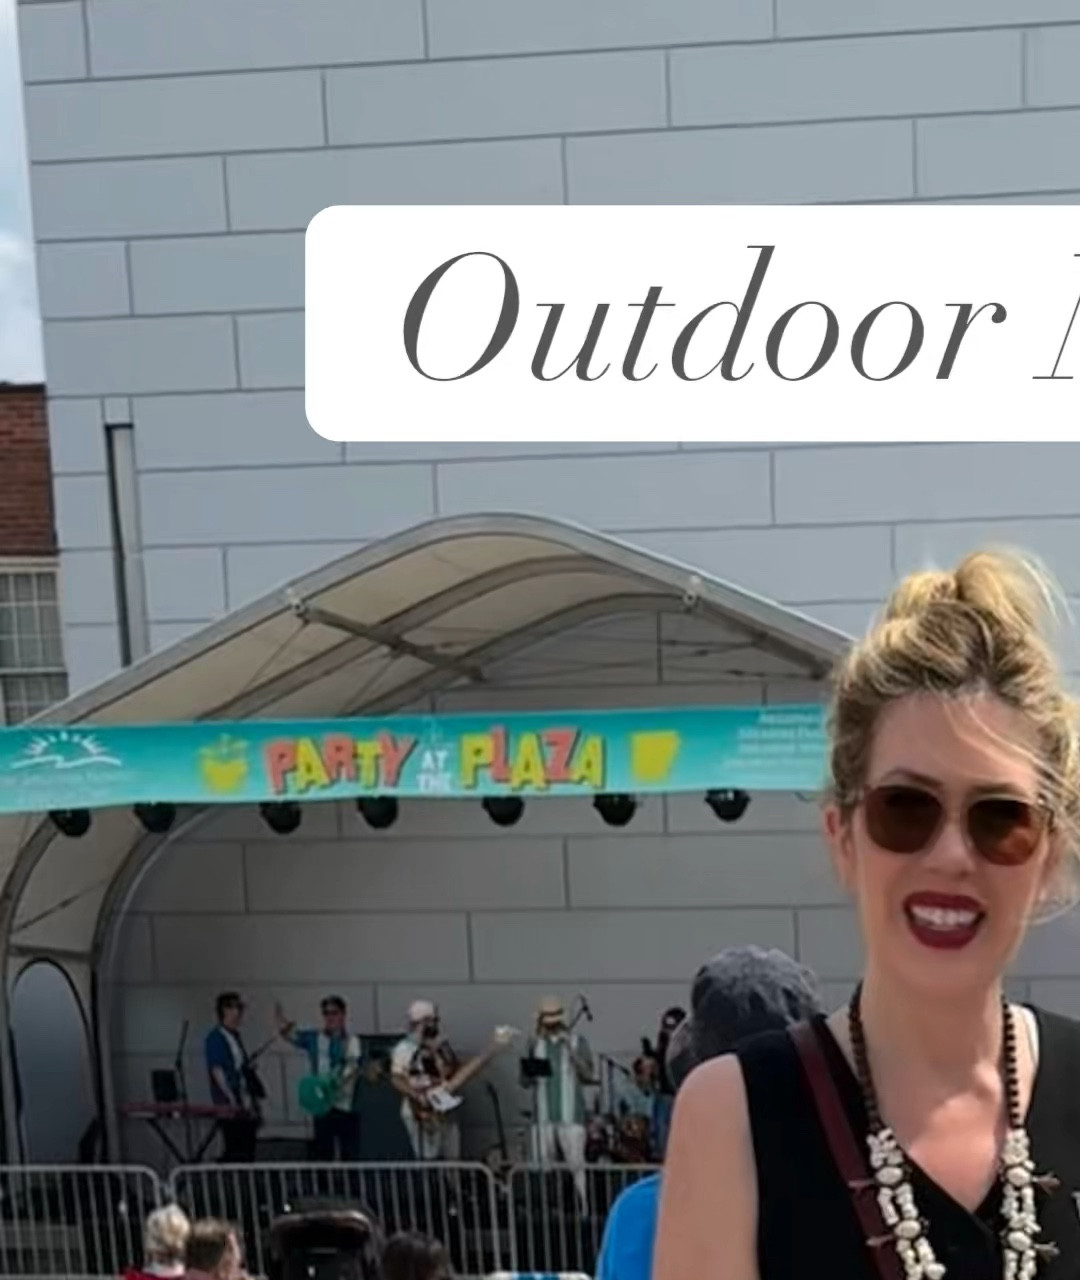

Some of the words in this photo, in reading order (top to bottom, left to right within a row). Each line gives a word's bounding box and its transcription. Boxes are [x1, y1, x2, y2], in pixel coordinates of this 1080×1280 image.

[265, 731, 418, 795] PARTY
[421, 750, 448, 769] AT
[460, 727, 605, 790] PLAZA
